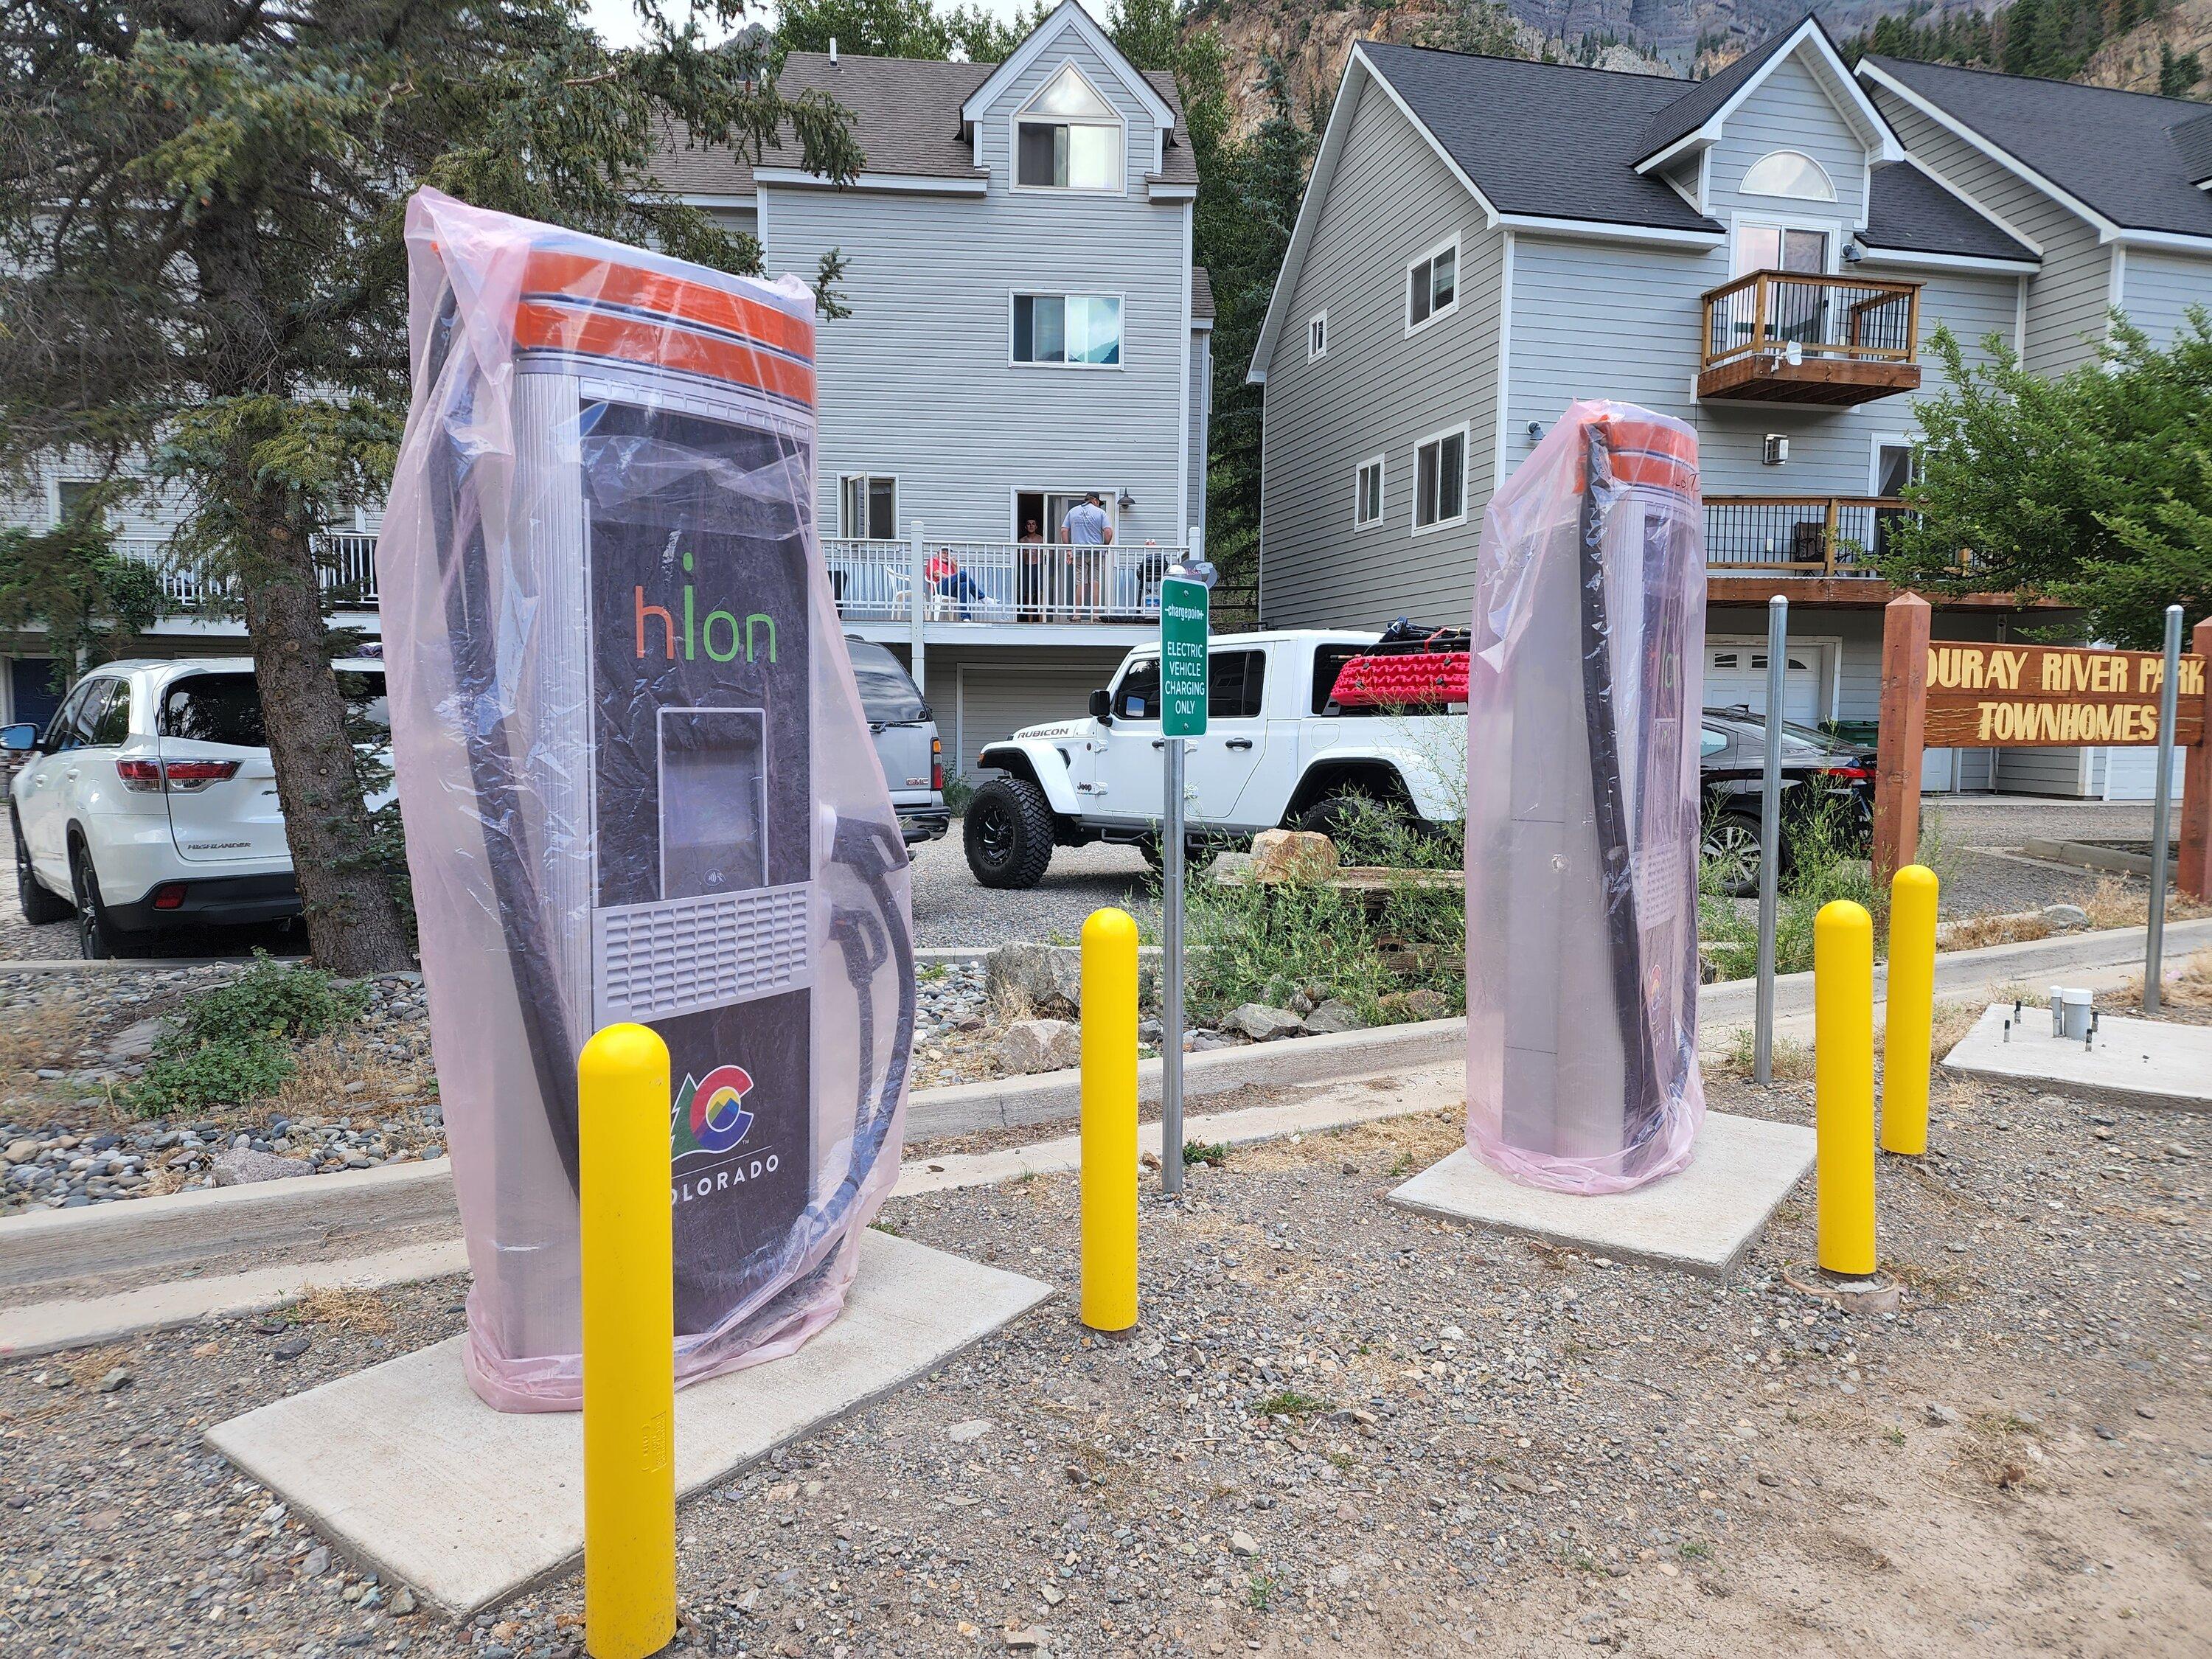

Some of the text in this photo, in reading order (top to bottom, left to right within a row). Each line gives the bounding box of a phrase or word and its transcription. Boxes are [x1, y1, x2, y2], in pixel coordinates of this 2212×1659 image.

[635, 552, 776, 663] hion
[1167, 641, 1203, 658] ELECTRIC
[1169, 661, 1201, 677] VEHICLE
[2042, 653, 2129, 693] RIVER
[2138, 658, 2207, 695] PARK
[1164, 680, 1205, 696] CHARGING
[1175, 700, 1196, 714] ONLY
[1978, 701, 2158, 741] TOWNHOMES
[1017, 728, 1069, 739] RUBICON
[906, 777, 929, 786] GMC
[1077, 782, 1092, 793] Jeep
[187, 842, 251, 850] HIGHLANDER
[672, 1154, 779, 1206] LORADO
